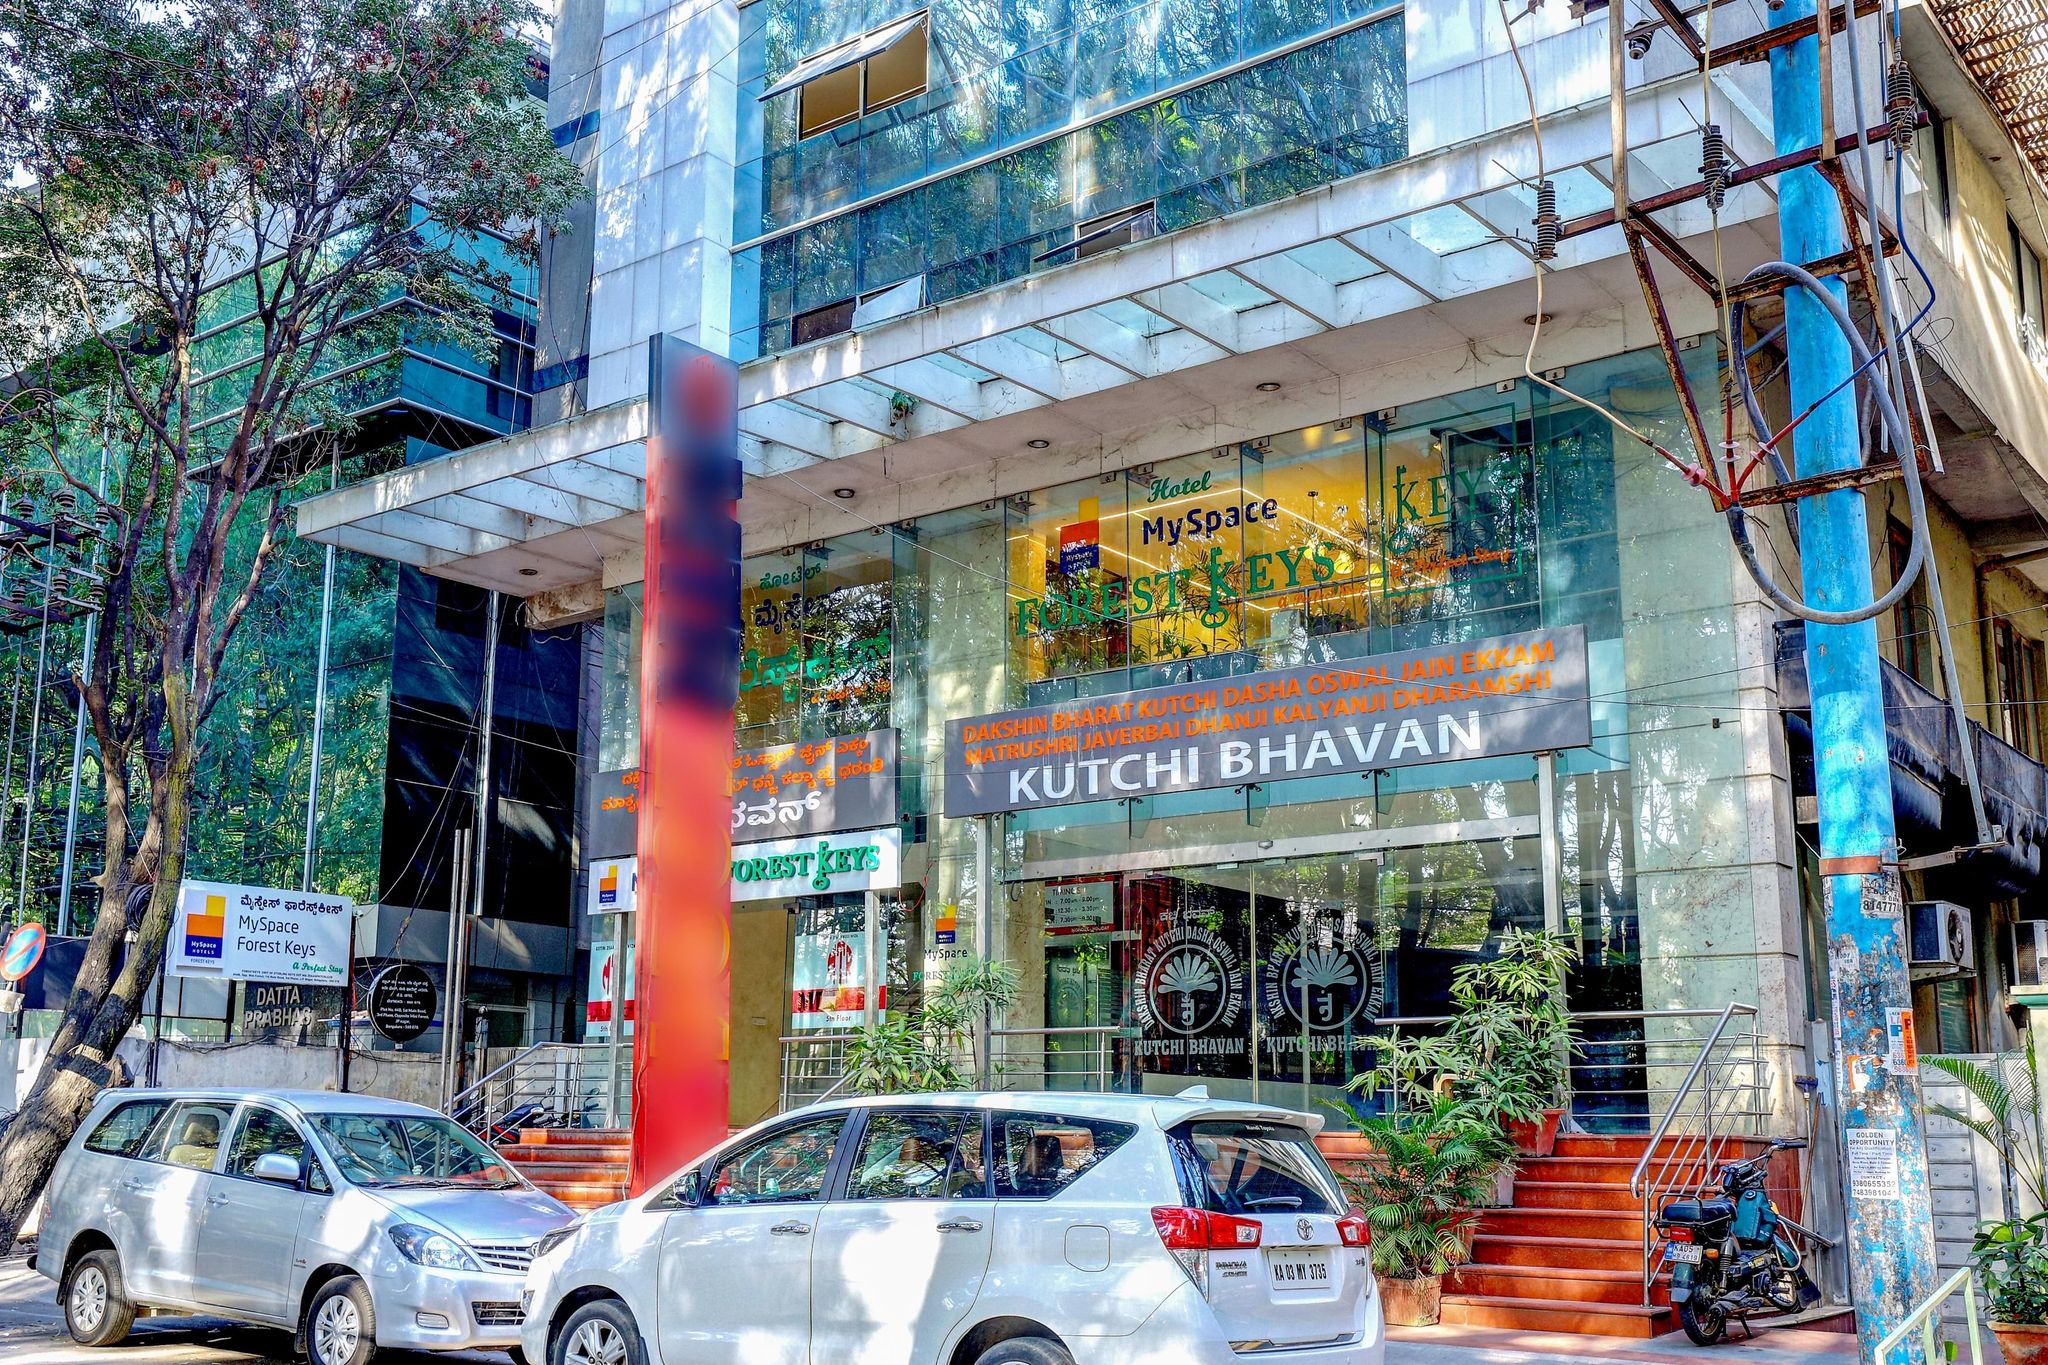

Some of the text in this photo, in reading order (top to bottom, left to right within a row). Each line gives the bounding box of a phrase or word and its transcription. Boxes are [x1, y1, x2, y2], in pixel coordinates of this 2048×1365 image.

[1147, 470, 1212, 502] Hotel
[1142, 498, 1278, 546] MySpace
[760, 563, 821, 590] ಹೋಟೆಲ್
[1016, 542, 1335, 636] FOREST KEYS
[963, 640, 1555, 745] DAKSHIN BHARAT KUTCHI DASHA OSWAL JAIN EKKAM
[964, 669, 1551, 766] MATRUSHRI JAVERBAI DHANJI KALYANJI DHARAMSHI
[800, 739, 833, 765] ಜೈನ್
[1009, 710, 1481, 804] KUTCHI BHAVAN
[812, 841, 880, 890] KEYS
[239, 915, 299, 935] MySpace
[191, 941, 217, 949] MySpace
[237, 937, 316, 958] Forest Keys
[925, 948, 968, 961] MySpace
[301, 963, 326, 973] Perfect
[328, 965, 344, 975] Stay
[1134, 925, 1243, 1031] DAKSHIN BHARAT KUTCHI DASHA OSWAL JAIN EKKAM
[257, 985, 300, 1006] DATTA
[244, 1006, 312, 1029] PRABHAS
[1134, 1037, 1245, 1056] KUTCHI BHAVAN
[1266, 1035, 1322, 1052] KUTCHI
[1274, 1263, 1327, 1280] KA 03 MY 3735
